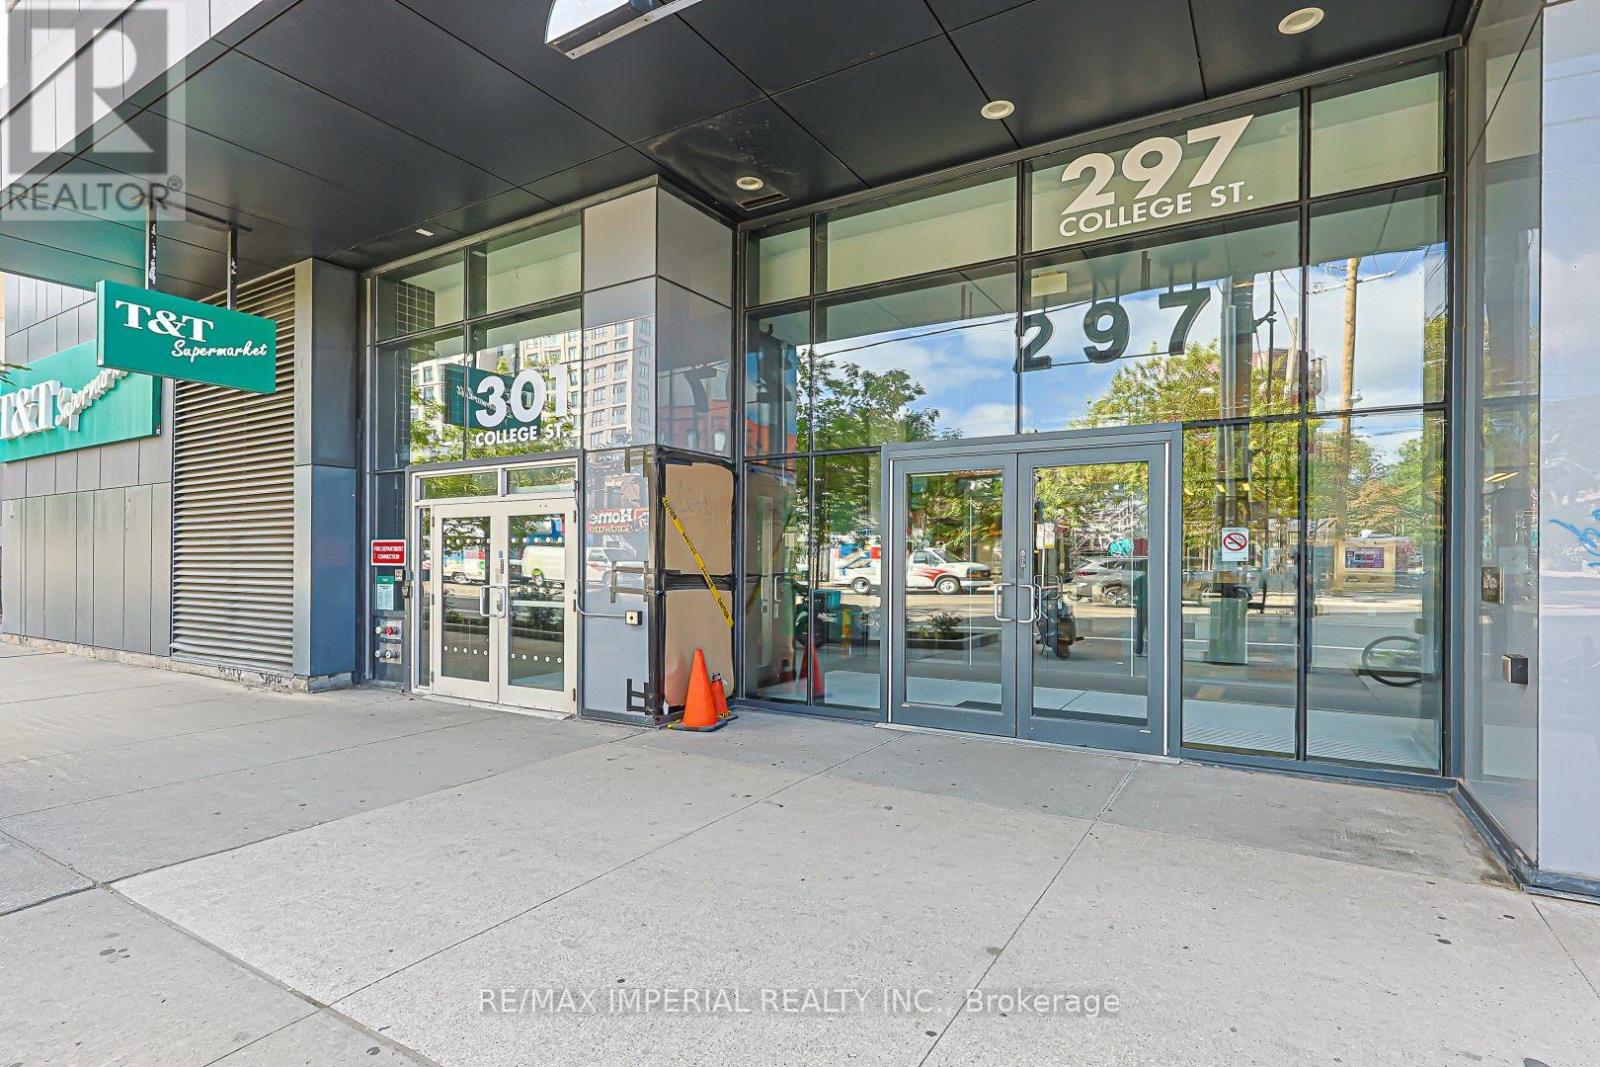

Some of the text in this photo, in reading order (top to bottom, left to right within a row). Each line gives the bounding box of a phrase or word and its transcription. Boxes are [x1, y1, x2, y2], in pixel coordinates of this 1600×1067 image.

[1060, 114, 1254, 215] 297
[1059, 181, 1254, 237] COLLEGE ST.
[115, 299, 214, 343] T&T
[1013, 287, 1211, 372] 297
[171, 340, 268, 363] Supermarket
[475, 364, 568, 428] 301
[475, 423, 567, 446] COLLEGE ST.
